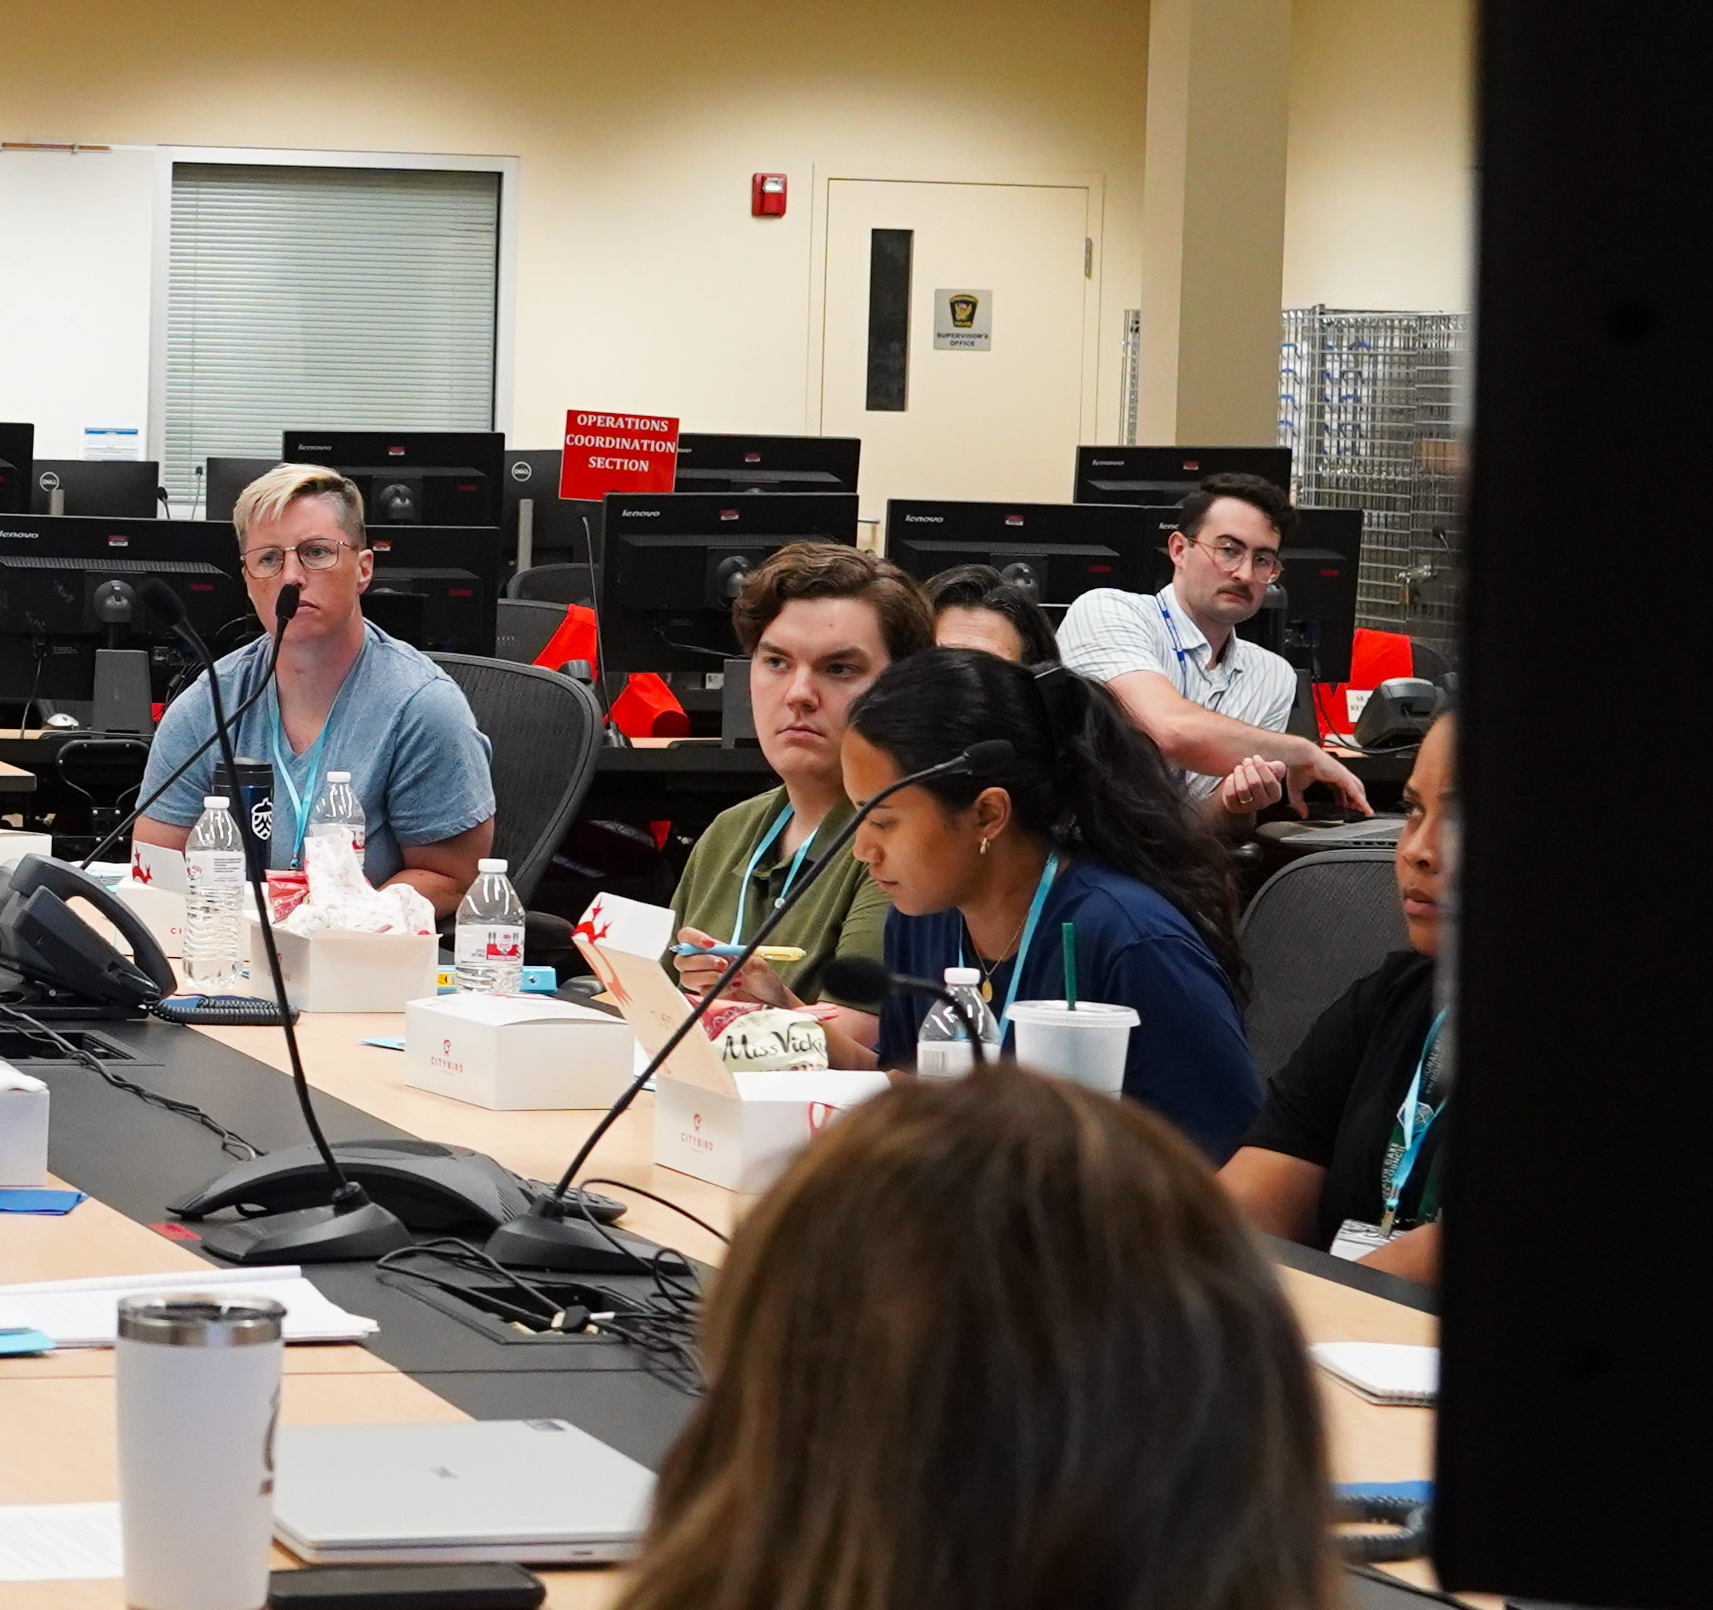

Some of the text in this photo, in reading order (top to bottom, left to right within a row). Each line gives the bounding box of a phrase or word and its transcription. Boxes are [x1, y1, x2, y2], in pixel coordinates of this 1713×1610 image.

[576, 414, 670, 433] OPERATIONS
[565, 433, 677, 454] COORDINATION
[588, 456, 650, 472] SECTION
[621, 508, 661, 517] lenovo
[905, 514, 944, 523] lenovo
[722, 1034, 778, 1060] Miss
[430, 1056, 464, 1073] CITYBIRD
[681, 1132, 714, 1151] CITYBIRD
